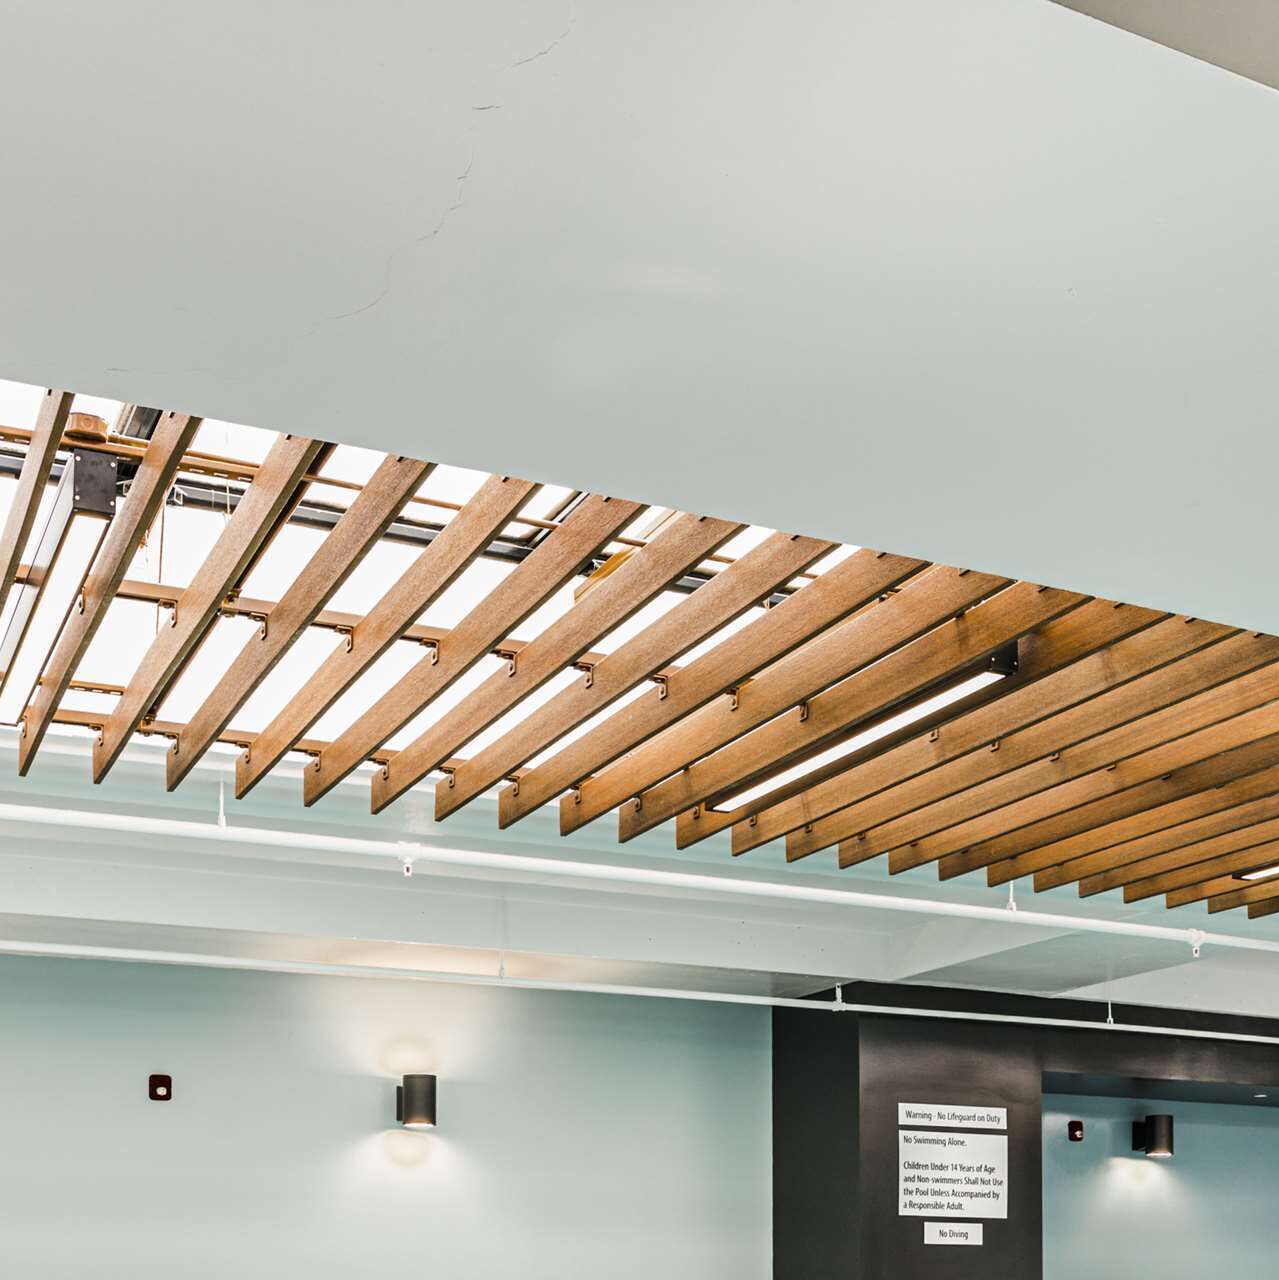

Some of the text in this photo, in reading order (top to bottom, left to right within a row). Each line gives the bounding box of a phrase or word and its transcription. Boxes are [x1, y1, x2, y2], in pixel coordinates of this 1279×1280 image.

[905, 1110, 932, 1121] Warning
[938, 1112, 946, 1120] No
[948, 1111, 976, 1122] Lifeguard
[987, 1114, 1000, 1124] Duty
[914, 1136, 946, 1147] Swimming
[948, 1138, 967, 1146] Alone.
[904, 1161, 995, 1174] Children Under 14 Years of Age
[904, 1175, 1003, 1186] and Non-swimmers Shall Not Use
[916, 1188, 929, 1196] Pool
[930, 1189, 950, 1197] Unless
[951, 1189, 991, 1199] Accompanied
[993, 1190, 1000, 1200] by
[909, 1201, 945, 1210] Responsible
[946, 1201, 964, 1210] Adult.
[939, 1230, 968, 1240] No Diving
